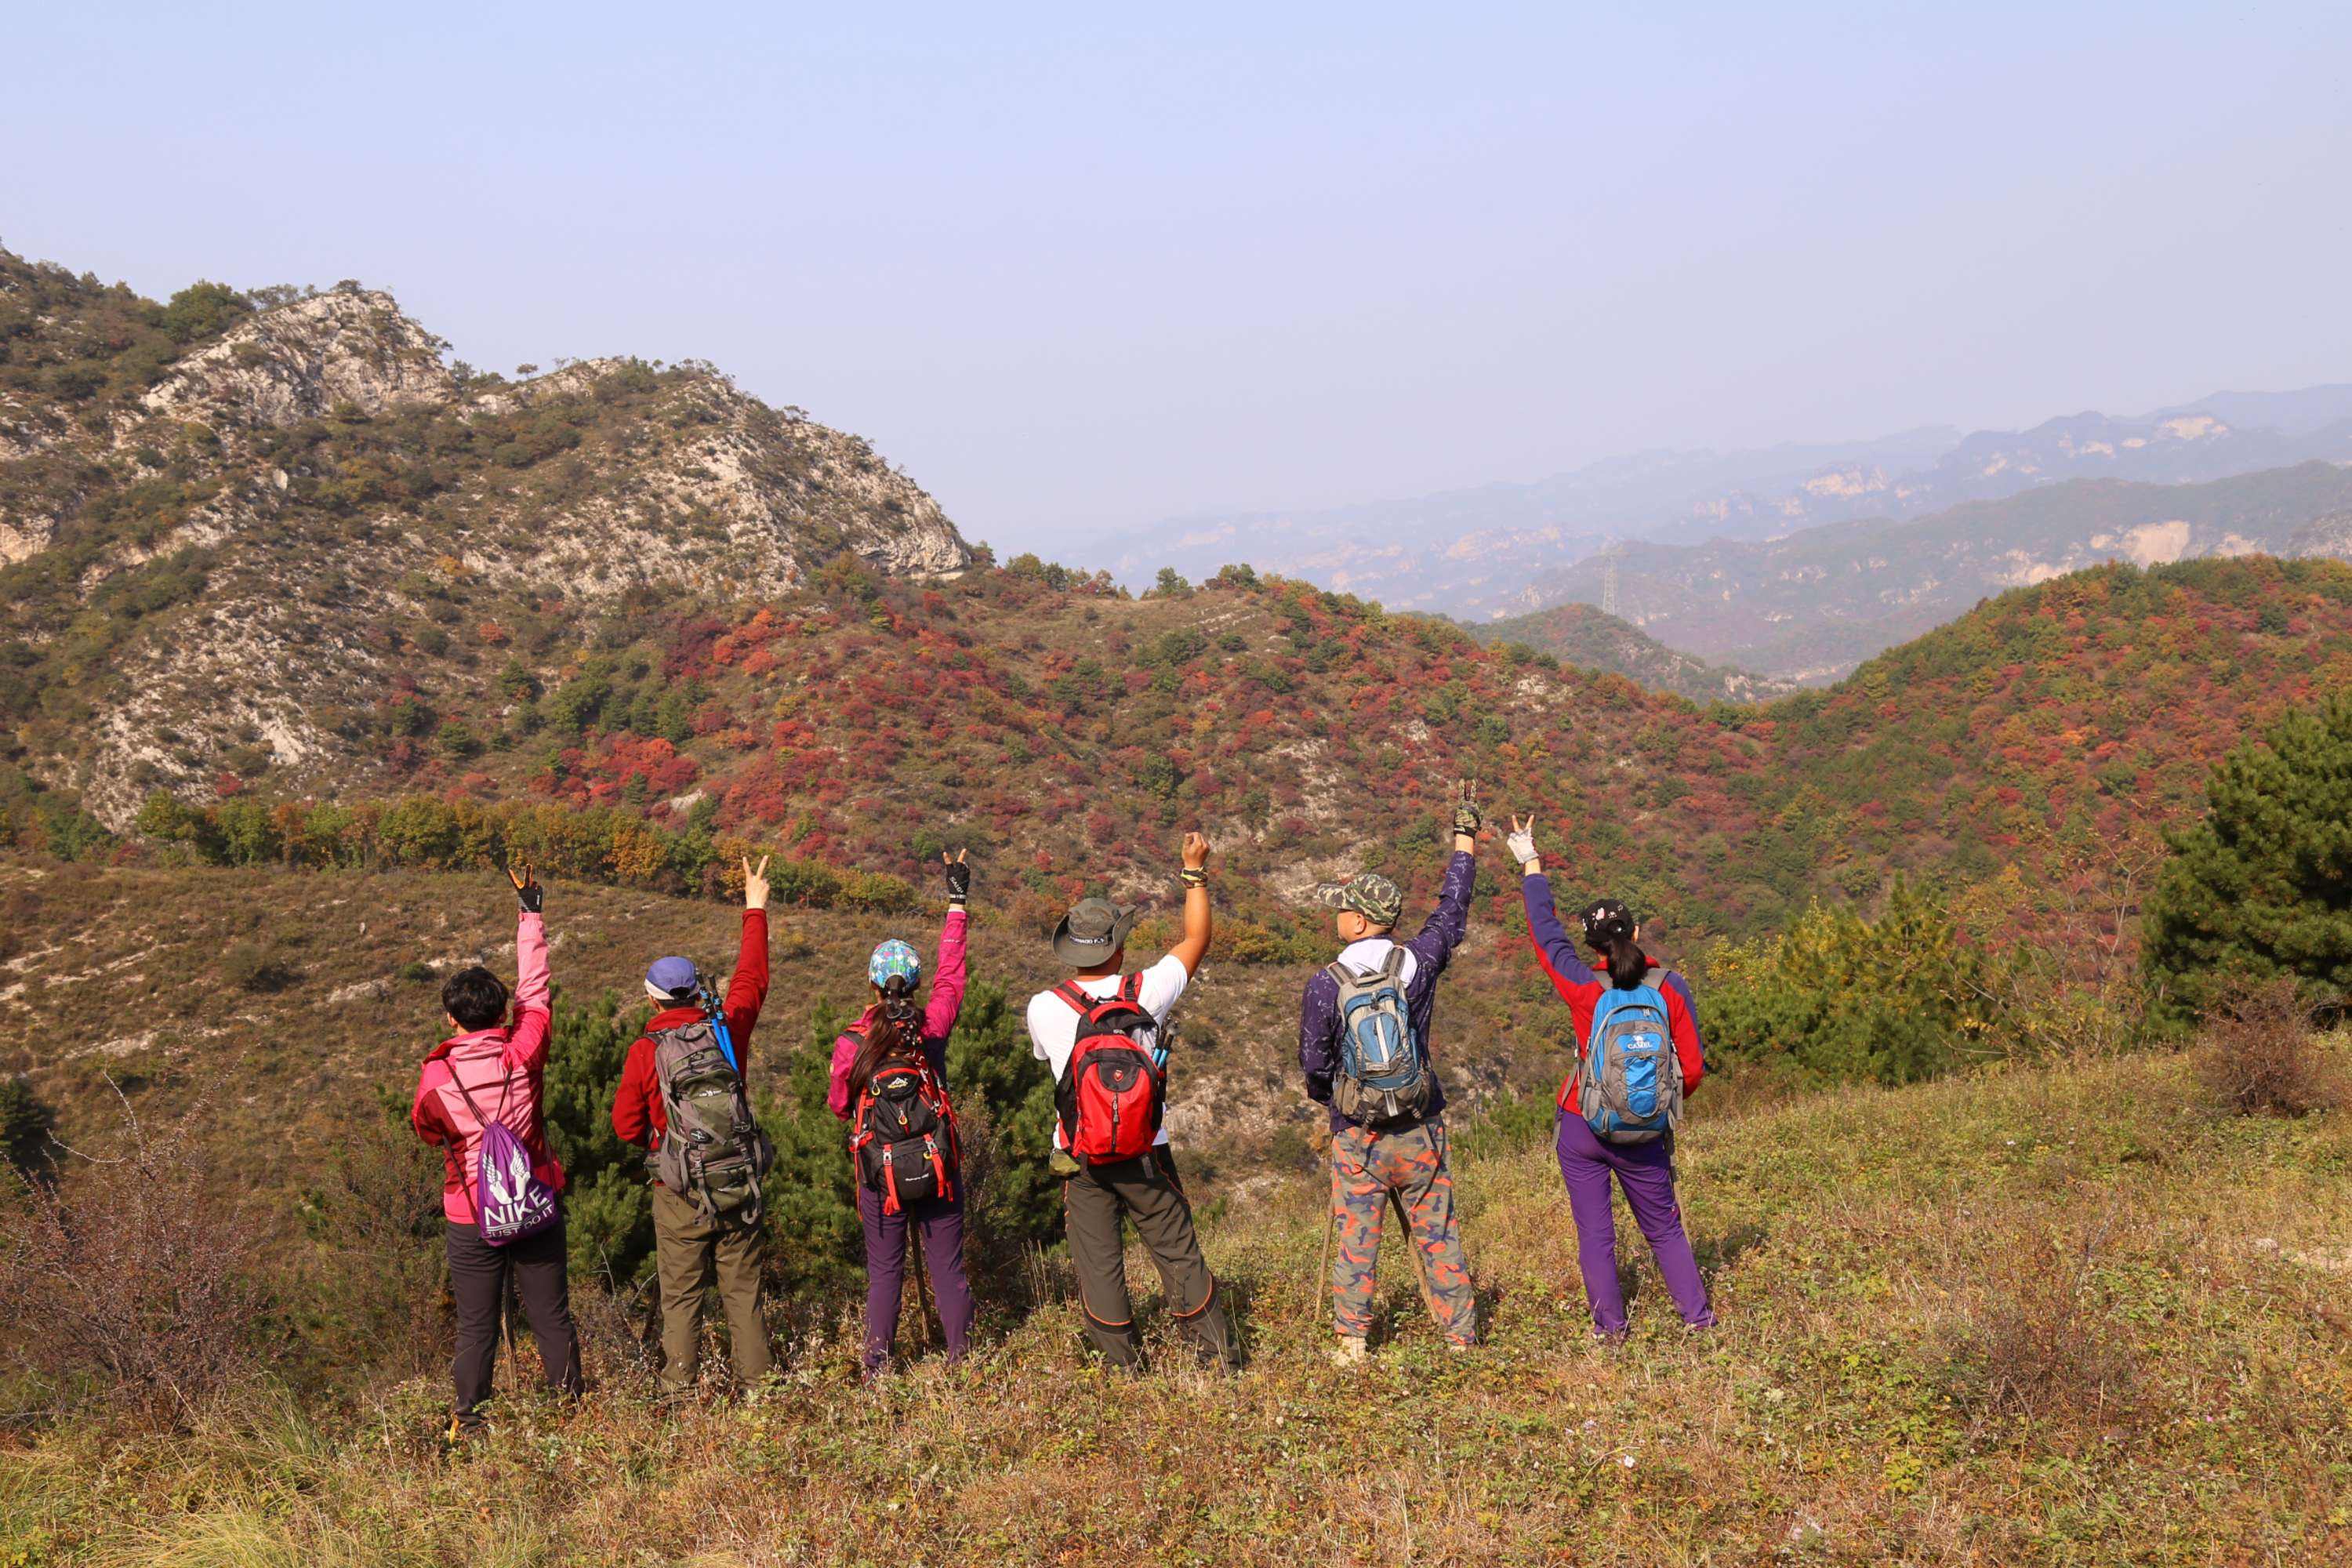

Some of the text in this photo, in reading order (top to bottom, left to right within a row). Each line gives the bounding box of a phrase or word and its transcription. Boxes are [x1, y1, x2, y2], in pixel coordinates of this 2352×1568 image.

[1627, 1040, 1653, 1049] CAMEL
[485, 1185, 547, 1226] NIKE
[542, 1204, 553, 1218] IT
